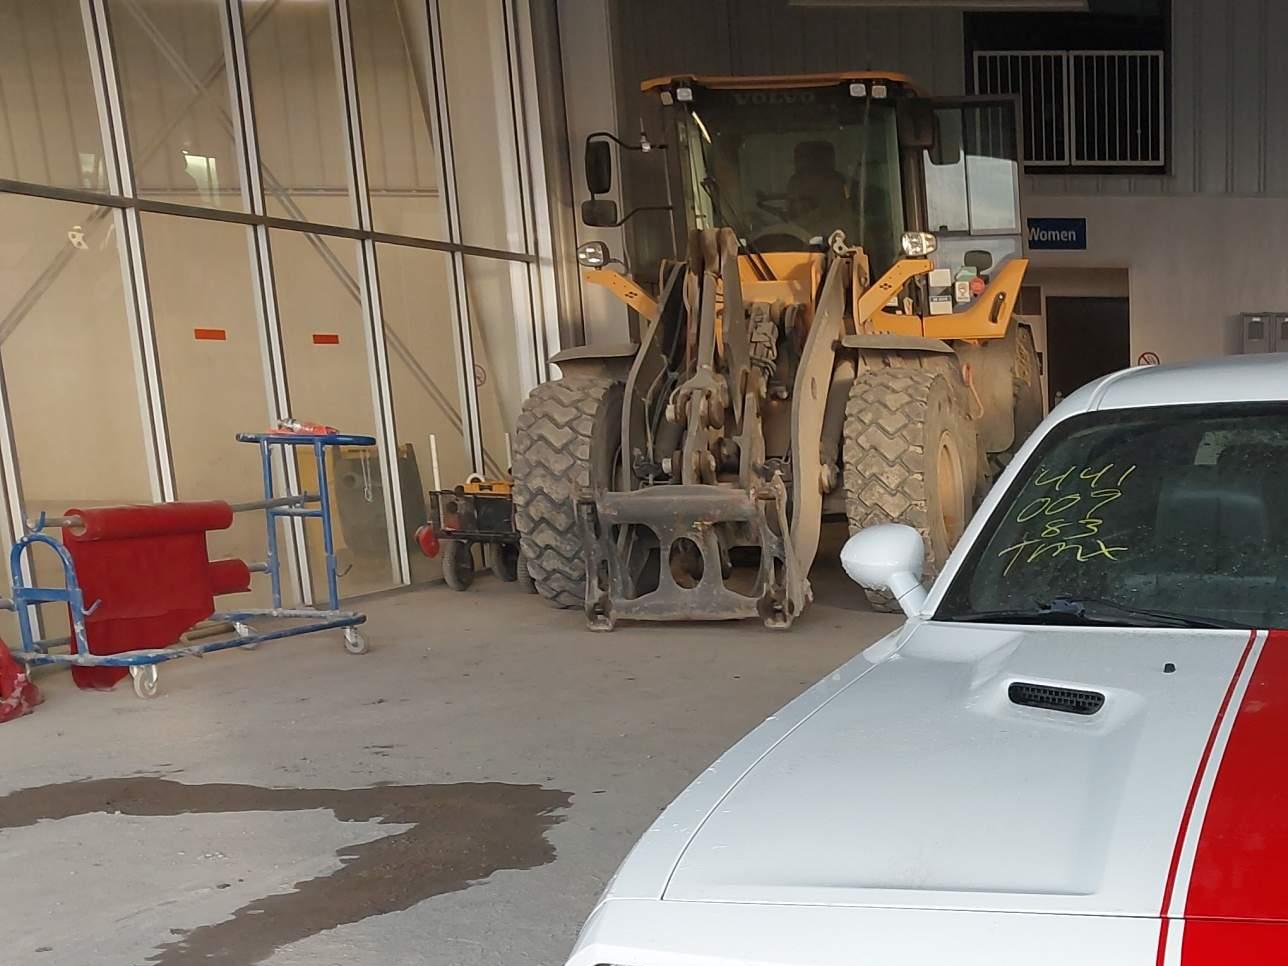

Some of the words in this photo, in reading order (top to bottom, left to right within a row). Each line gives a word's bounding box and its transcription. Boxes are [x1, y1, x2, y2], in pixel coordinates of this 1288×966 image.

[735, 93, 816, 105] VOLVO
[1029, 227, 1077, 241] Women
[1034, 463, 1137, 492] 441
[1040, 518, 1104, 540] 83
